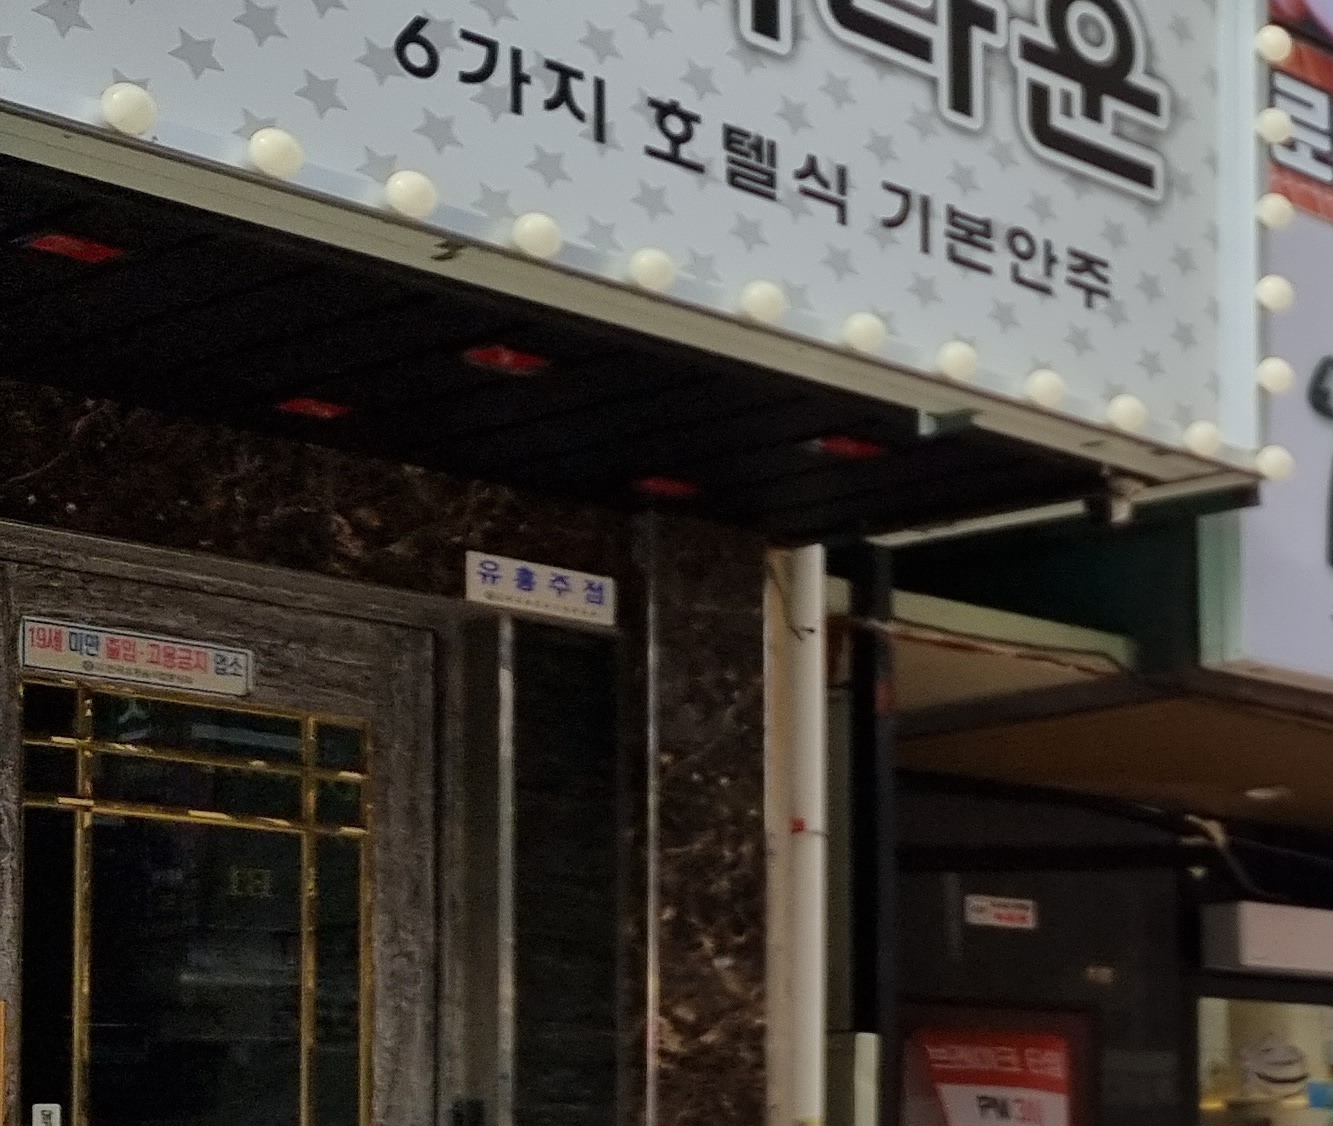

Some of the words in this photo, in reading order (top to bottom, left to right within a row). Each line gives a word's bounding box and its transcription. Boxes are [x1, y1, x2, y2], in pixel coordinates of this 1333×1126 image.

[394, 15, 608, 144] 6가지
[644, 97, 849, 226] 호텔식
[880, 180, 1112, 309] 기본안주
